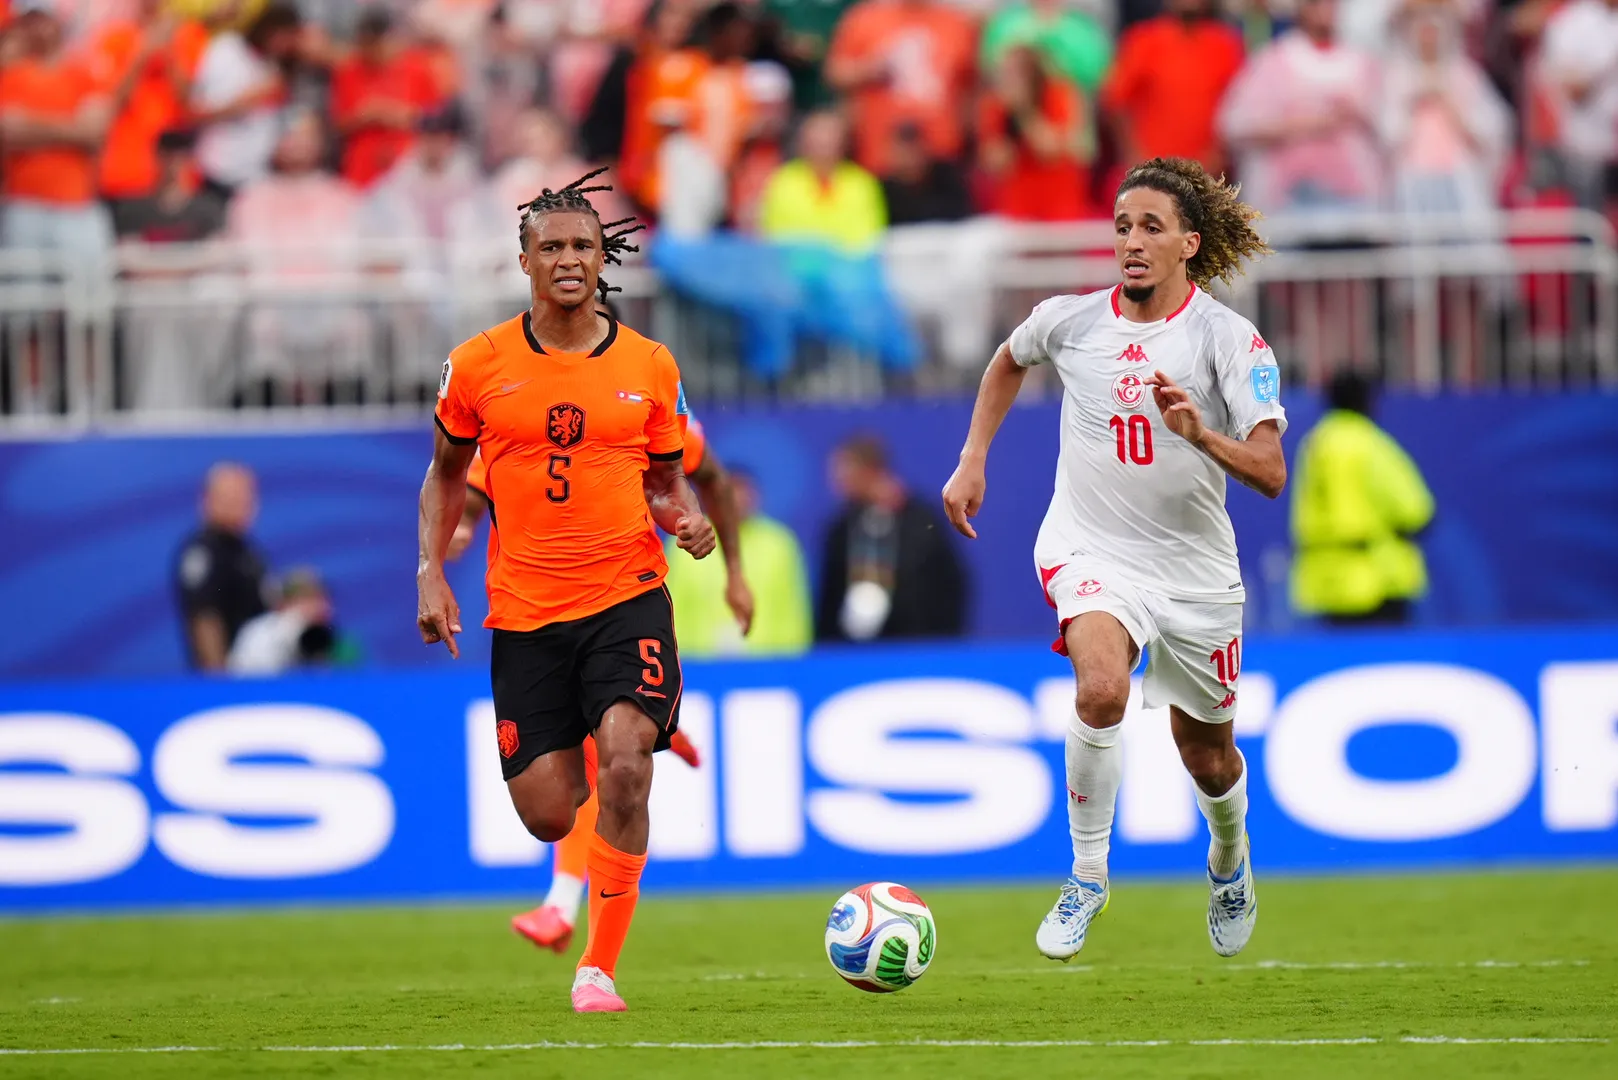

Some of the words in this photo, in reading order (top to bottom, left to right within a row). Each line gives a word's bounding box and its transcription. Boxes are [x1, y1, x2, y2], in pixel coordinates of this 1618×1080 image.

[1109, 414, 1154, 466] 10
[545, 454, 572, 503] 5
[638, 638, 664, 687] 5
[1209, 637, 1240, 688] 10
